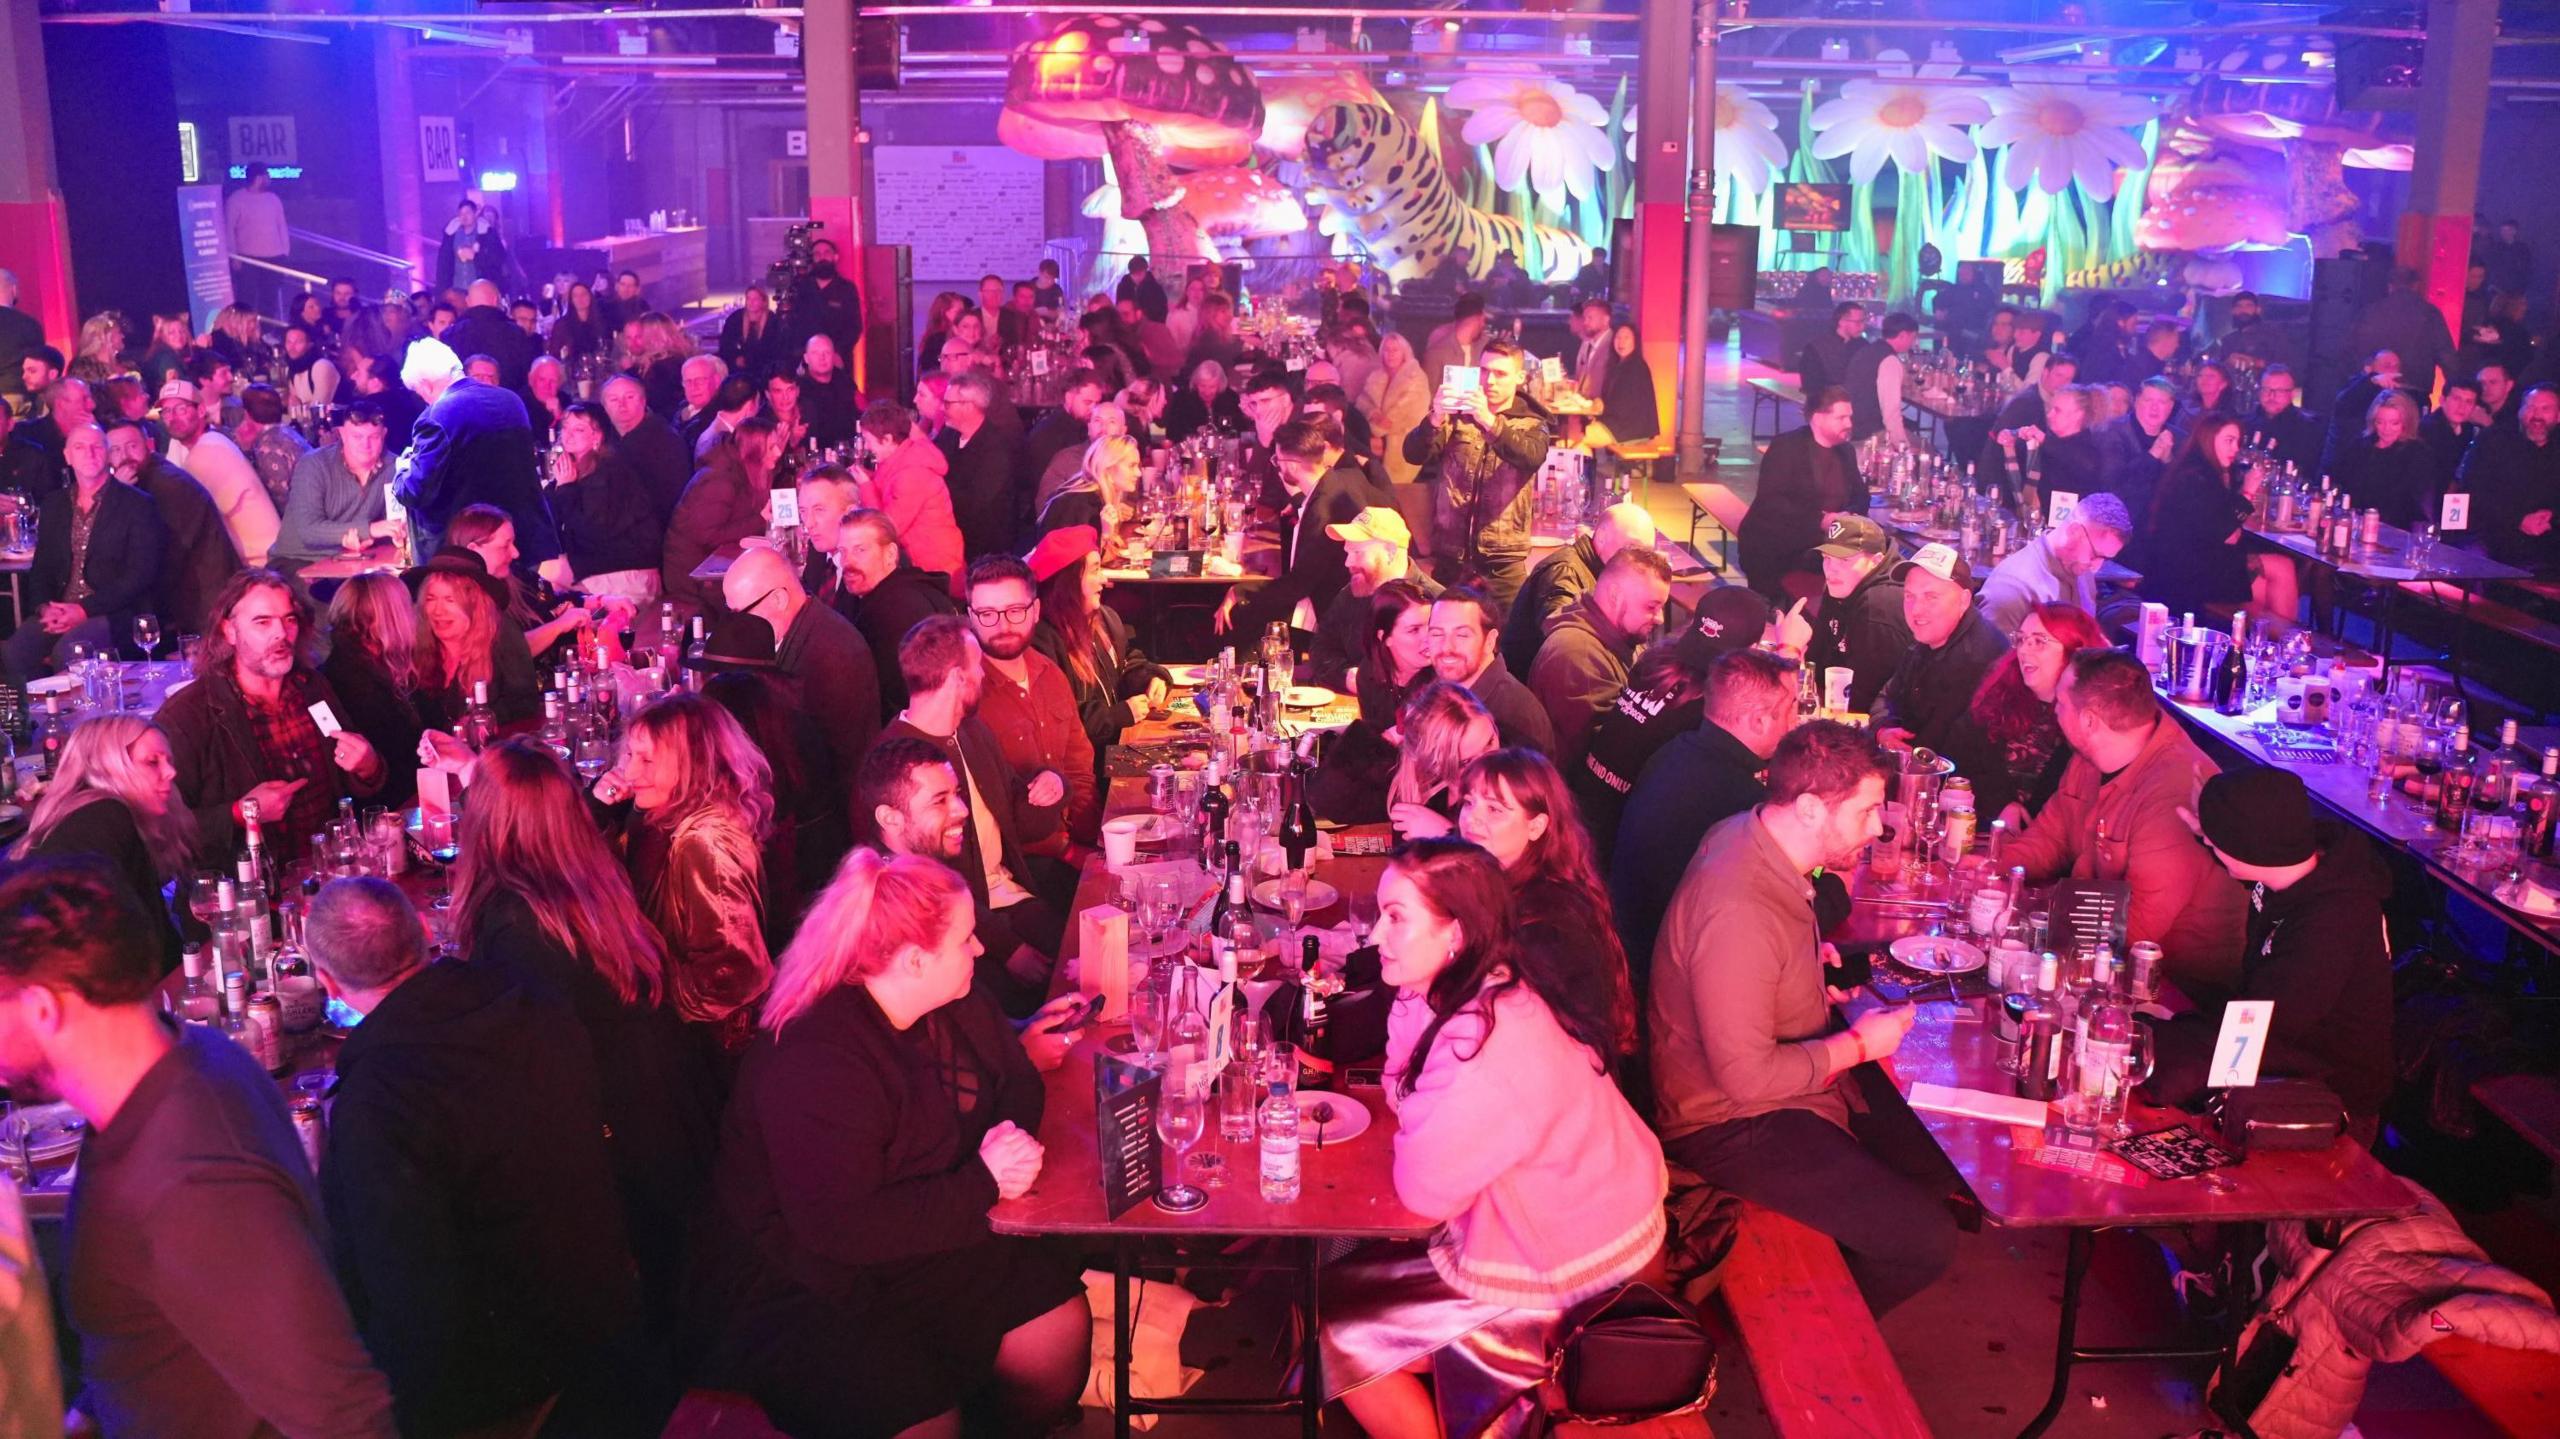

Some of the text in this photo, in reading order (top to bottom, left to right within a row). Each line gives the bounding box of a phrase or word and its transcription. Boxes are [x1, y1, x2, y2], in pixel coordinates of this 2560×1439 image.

[240, 123, 288, 156] BAR
[425, 126, 454, 170] BAR
[778, 503, 793, 518] 25
[2449, 508, 2460, 521] 21
[1605, 771, 1631, 794] ONLY
[1216, 1024, 1224, 1059] 8
[2230, 1035, 2249, 1068] 7
